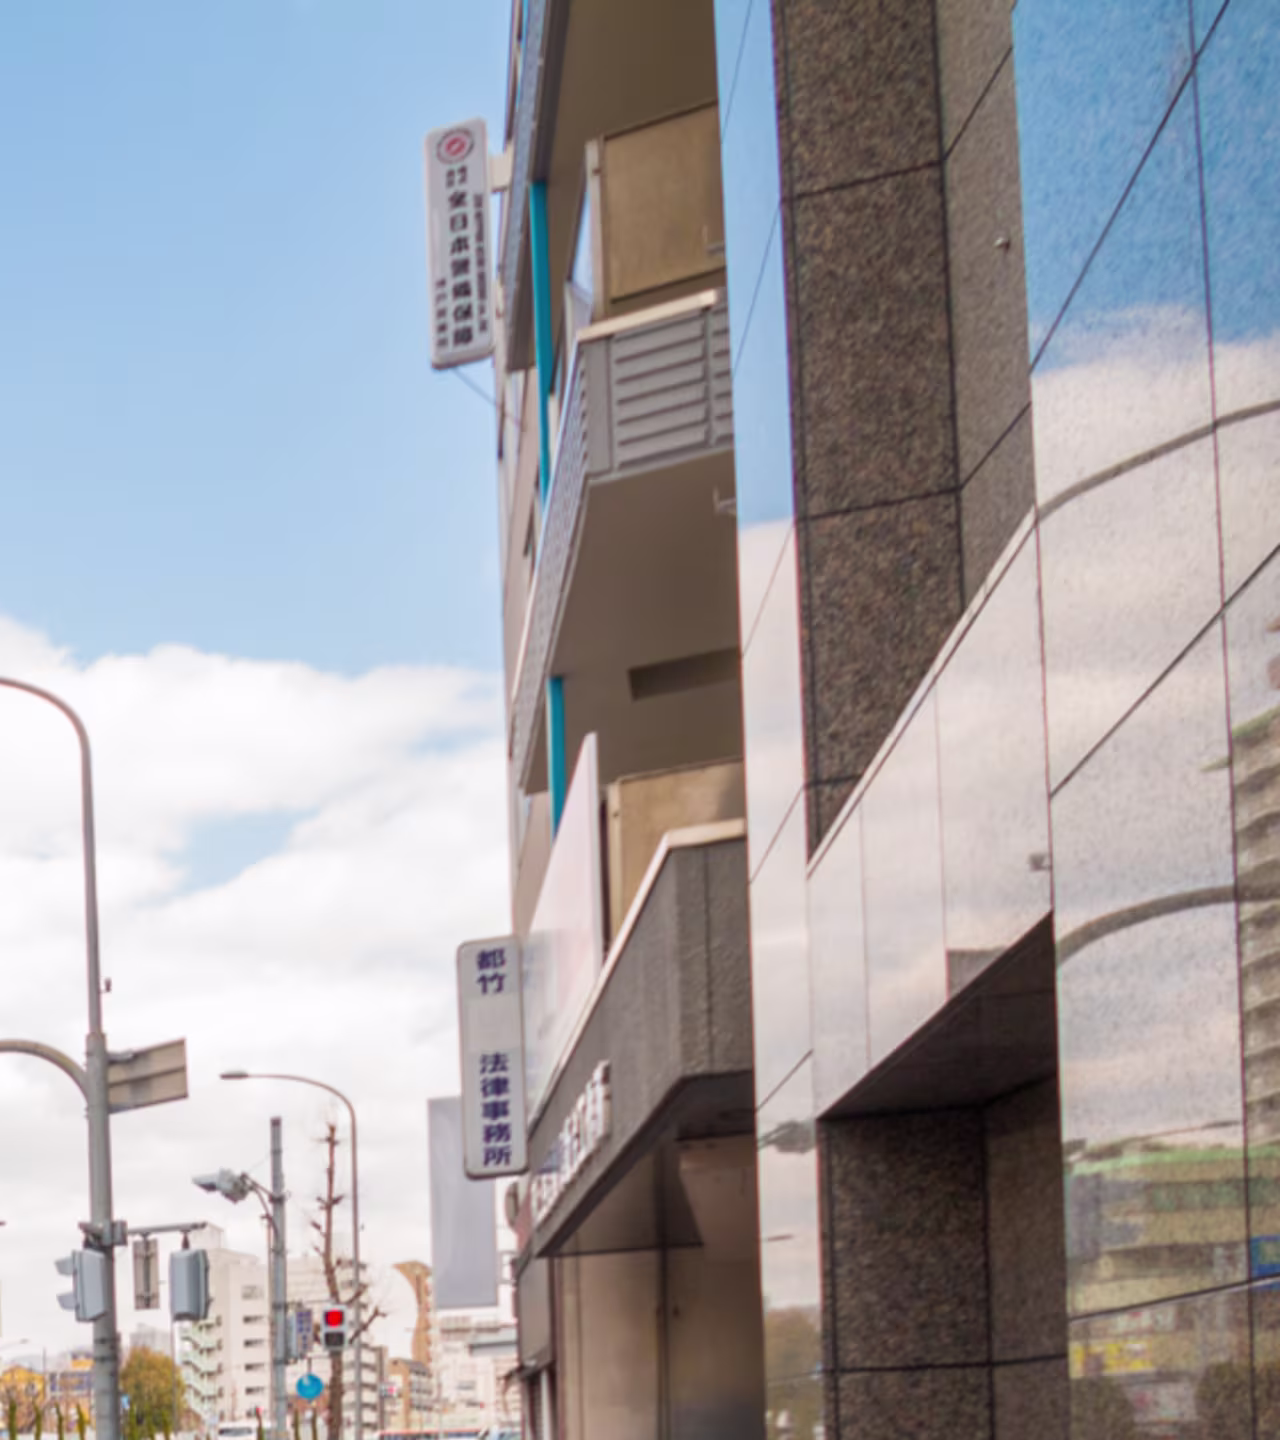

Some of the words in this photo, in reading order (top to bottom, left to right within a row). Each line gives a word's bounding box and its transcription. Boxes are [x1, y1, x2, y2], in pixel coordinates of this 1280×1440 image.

[476, 948, 506, 995] 都竹
[479, 1053, 511, 1166] 法律事務所
